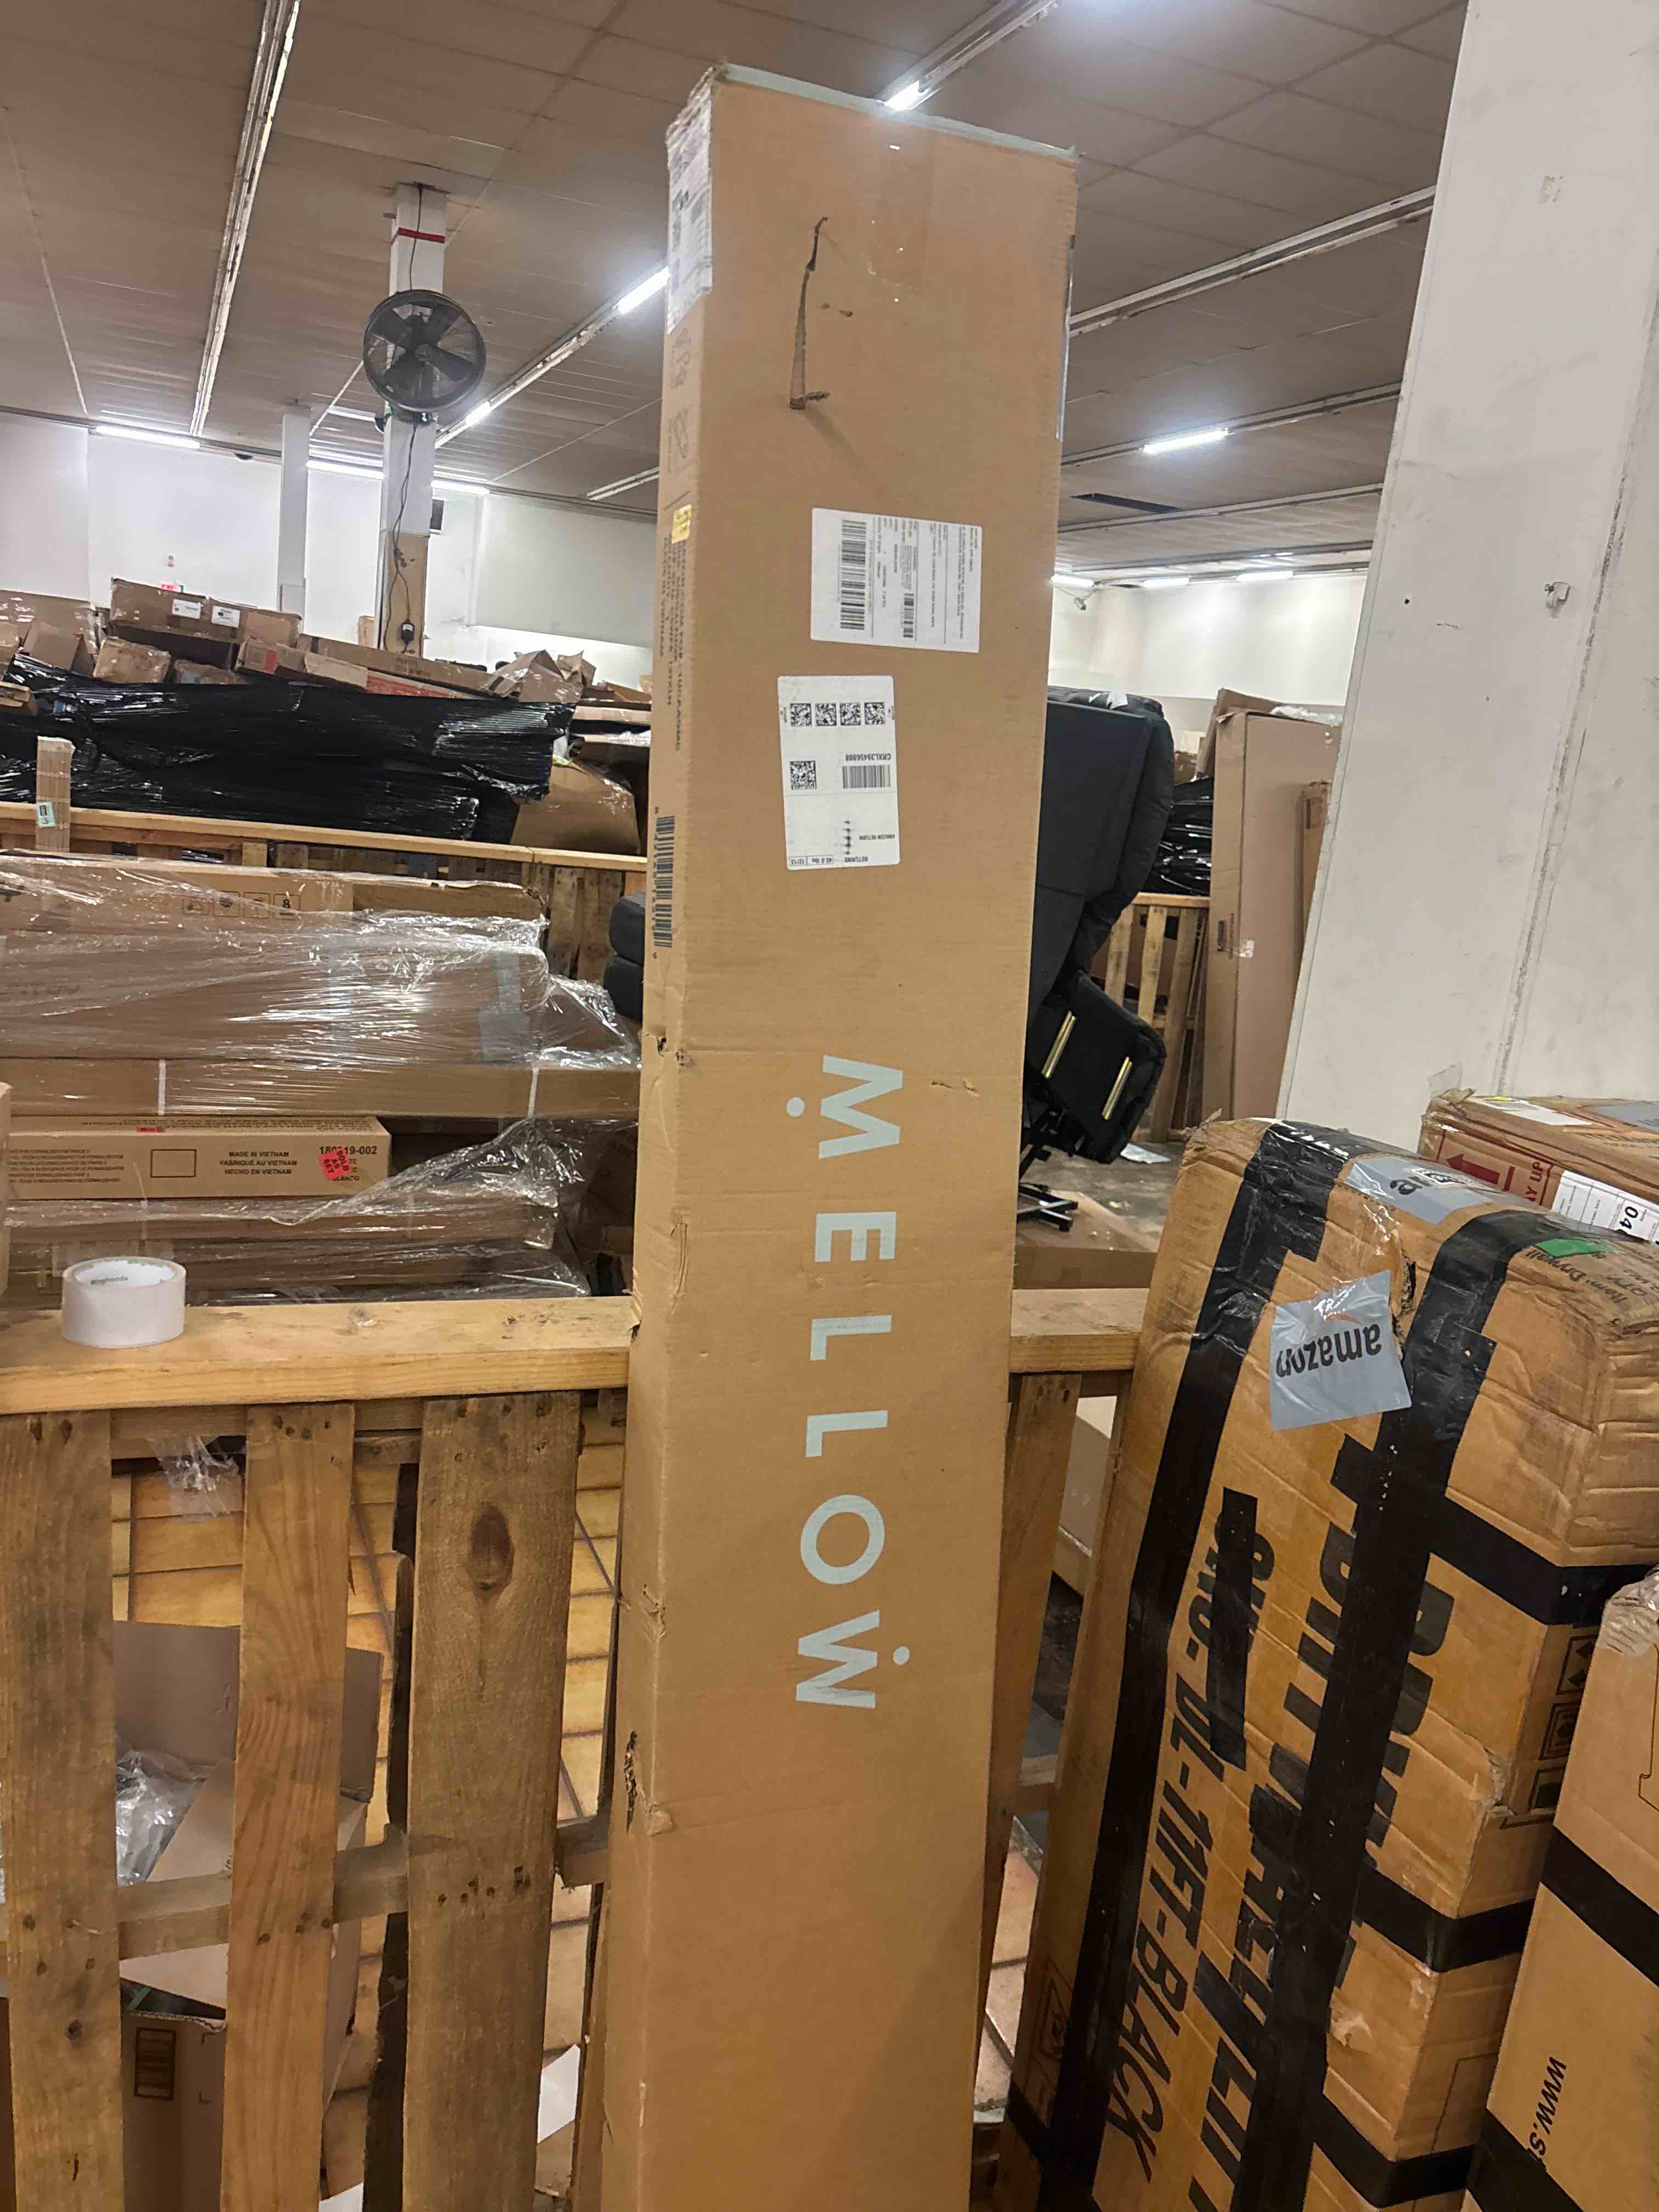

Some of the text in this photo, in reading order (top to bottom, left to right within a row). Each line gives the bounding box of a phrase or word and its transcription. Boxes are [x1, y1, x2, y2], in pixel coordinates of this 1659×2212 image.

[324, 1159, 334, 1173] SET
[331, 1159, 341, 1169] AS
[337, 1150, 349, 1172] SOLD
[1530, 1161, 1544, 1182] UP
[1276, 1323, 1382, 1378] amazon
[787, 1054, 910, 1709] MELLOW
